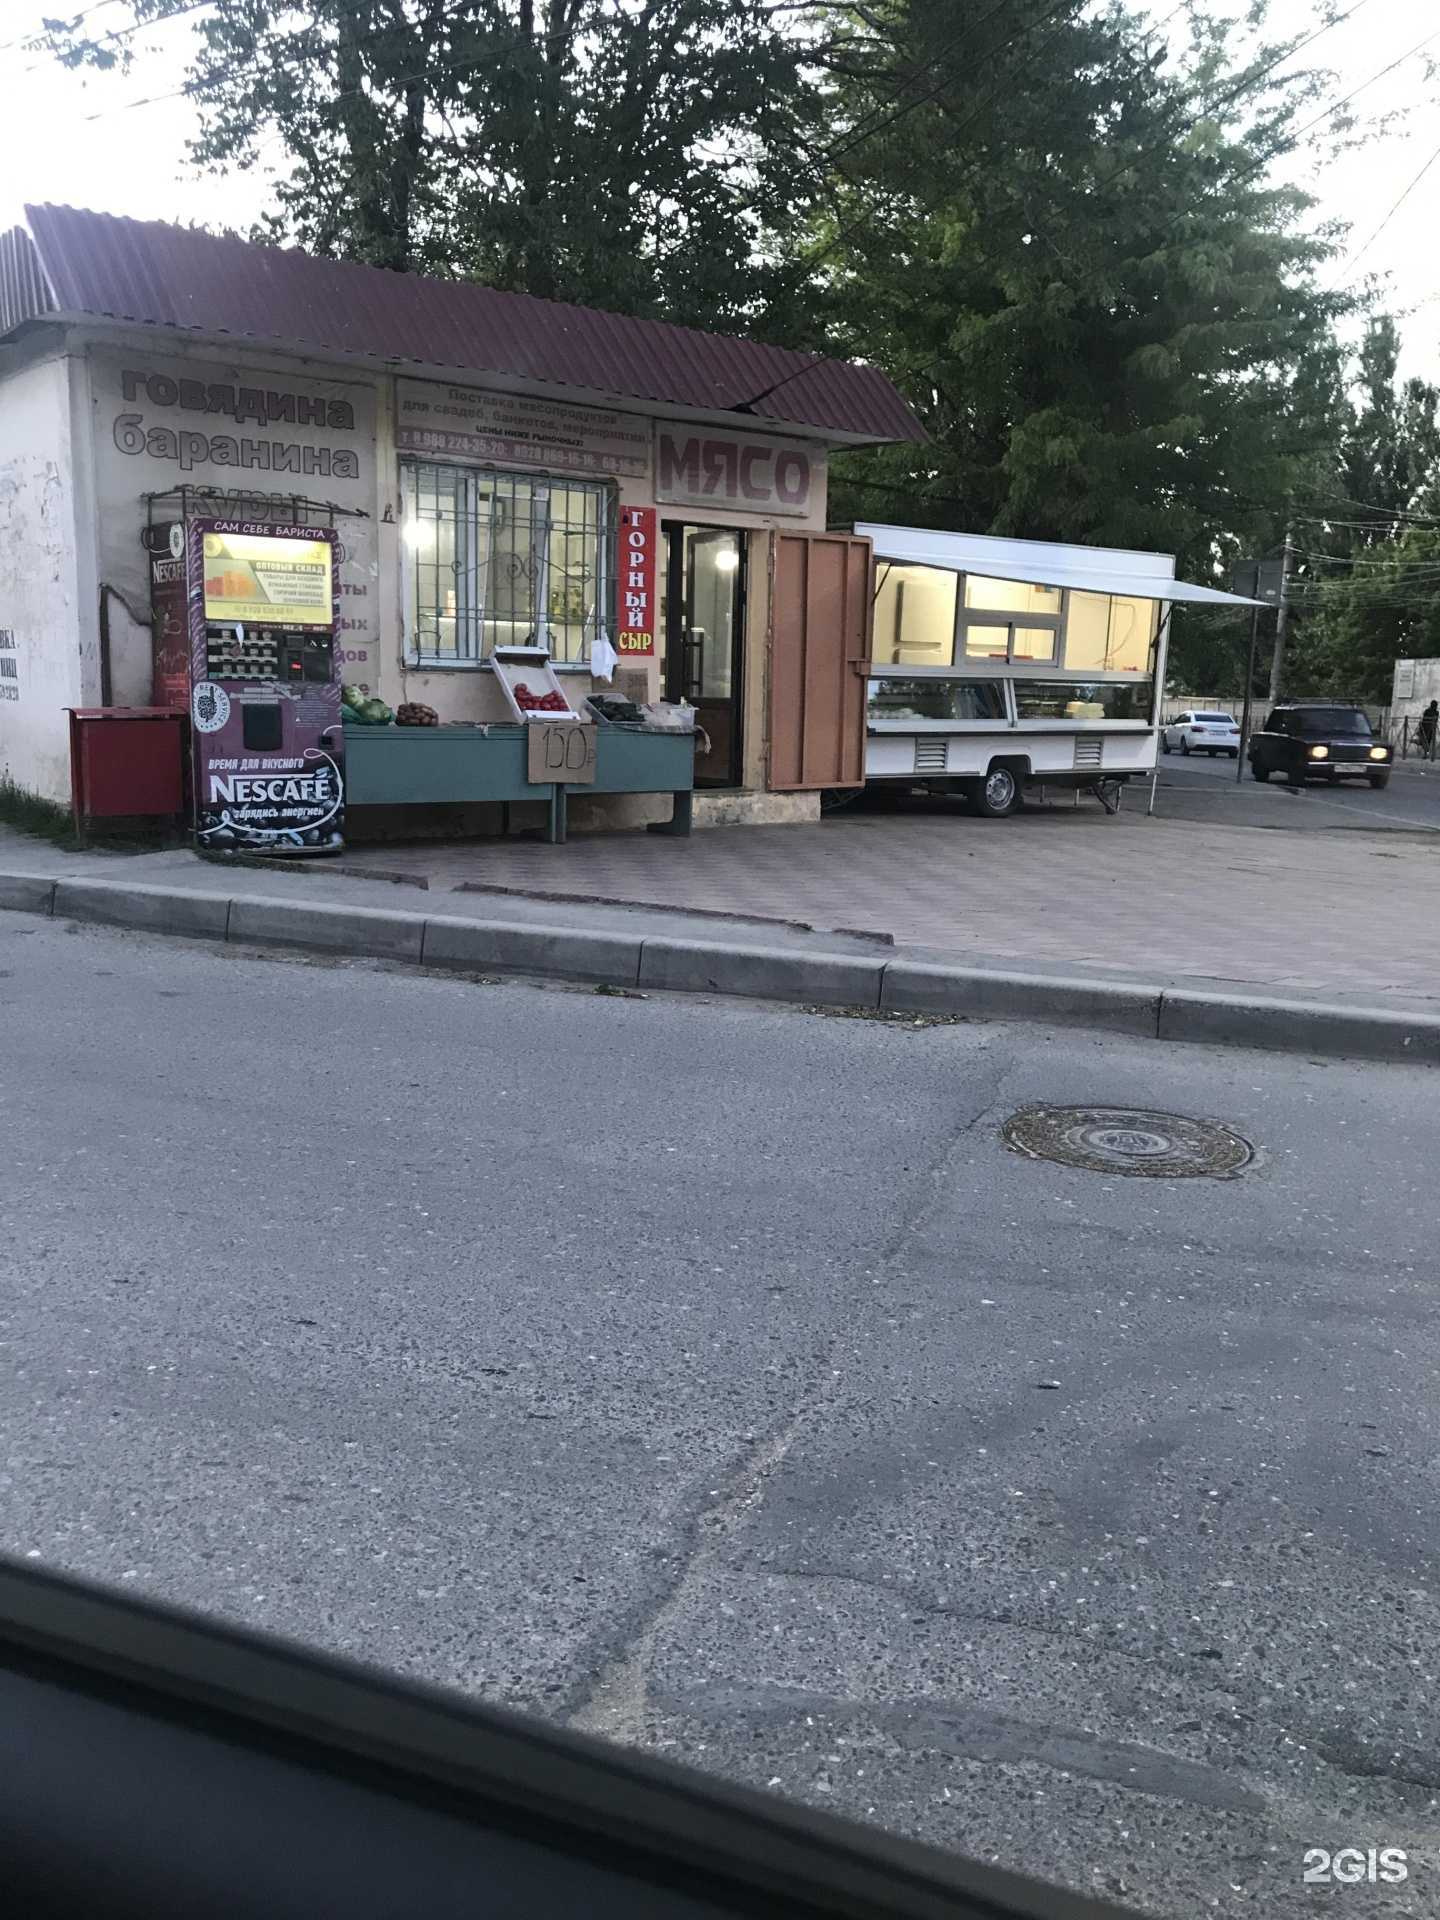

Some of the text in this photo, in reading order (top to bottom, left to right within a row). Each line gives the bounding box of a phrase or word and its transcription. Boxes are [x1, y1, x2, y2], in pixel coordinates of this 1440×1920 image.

[122, 370, 355, 430] говядина
[402, 400, 429, 413] для
[113, 413, 360, 478] баранина
[659, 434, 811, 505] МЯСО
[214, 521, 326, 538] САМ СЕБЕ БАРИСТА
[624, 510, 648, 628] ГОРНЫЙ
[619, 631, 652, 650] СЫР
[208, 758, 304, 771] ВРЕМЯ ДЛЯ ВКУСНОГО
